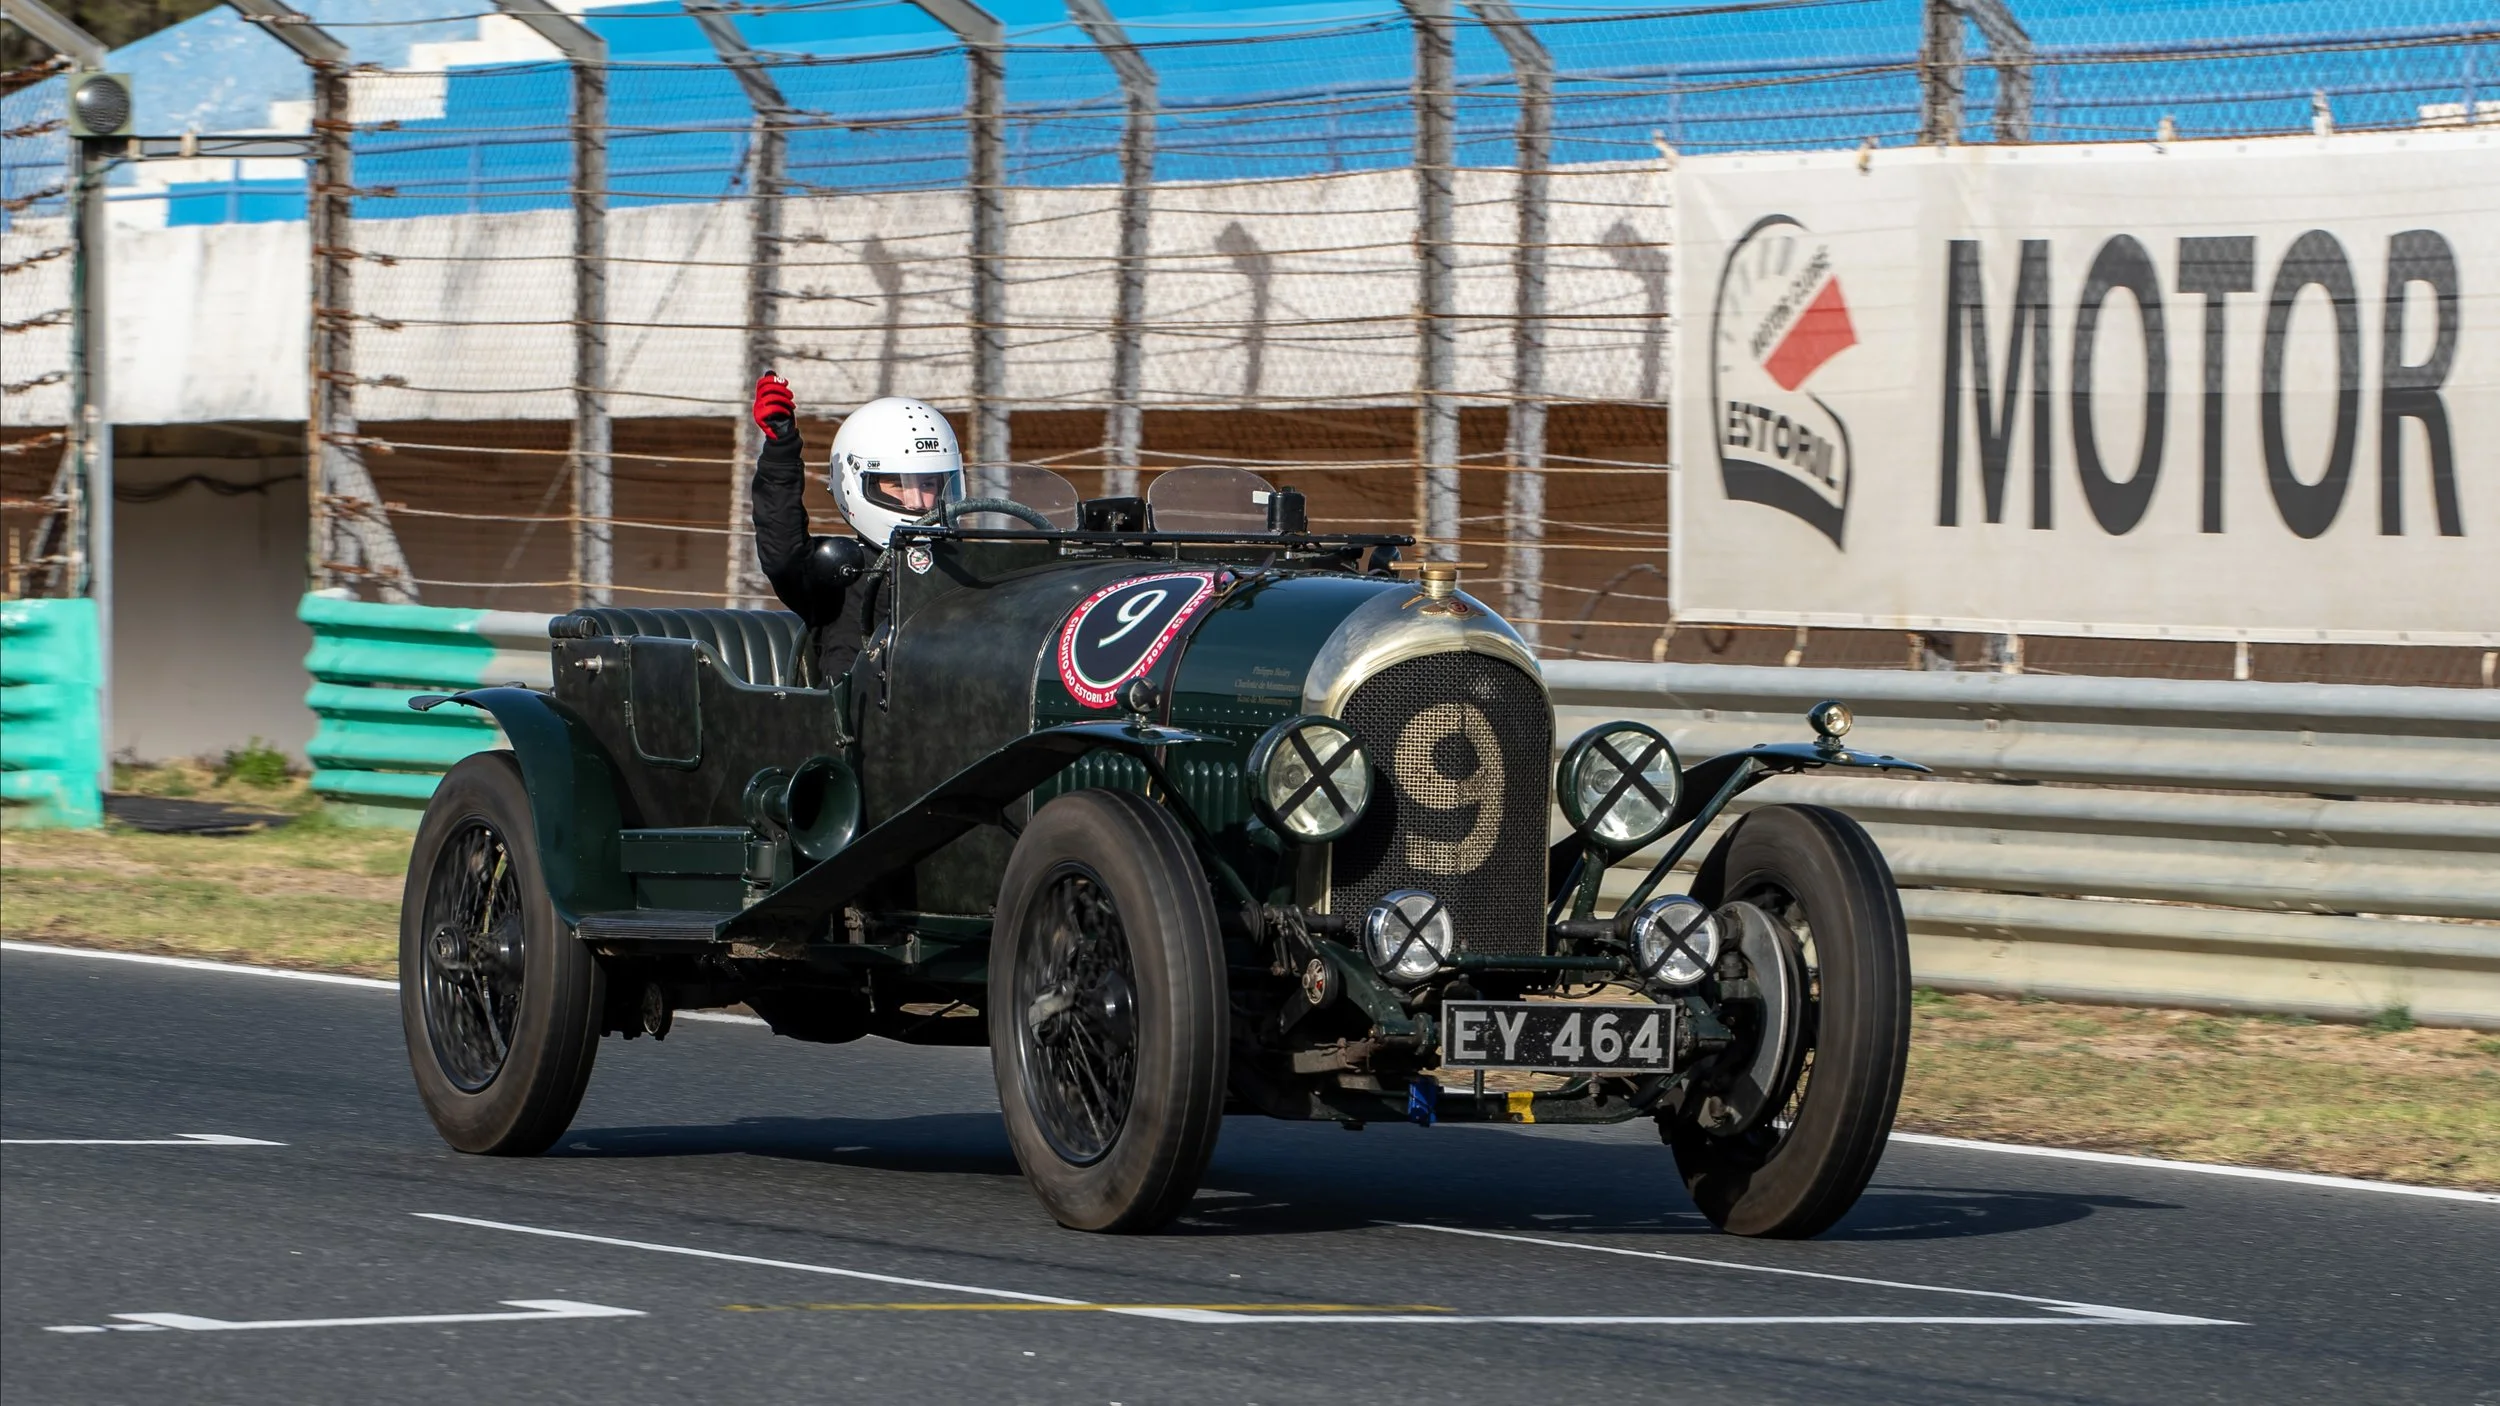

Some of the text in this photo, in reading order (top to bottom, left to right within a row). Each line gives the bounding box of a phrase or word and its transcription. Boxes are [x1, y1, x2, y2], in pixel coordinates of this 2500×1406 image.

[1934, 228, 2465, 539] MOTOR
[916, 439, 940, 451] OMP
[1725, 400, 1842, 490] ESTORIL
[1062, 616, 1079, 670] CIRCUITO
[1098, 589, 1169, 648] 9
[1147, 635, 1169, 664] 2026
[1065, 669, 1075, 686] DO
[1074, 683, 1103, 703] ESTORIL
[1394, 702, 1506, 876] 9
[1454, 1011, 1663, 1064] EY 464
